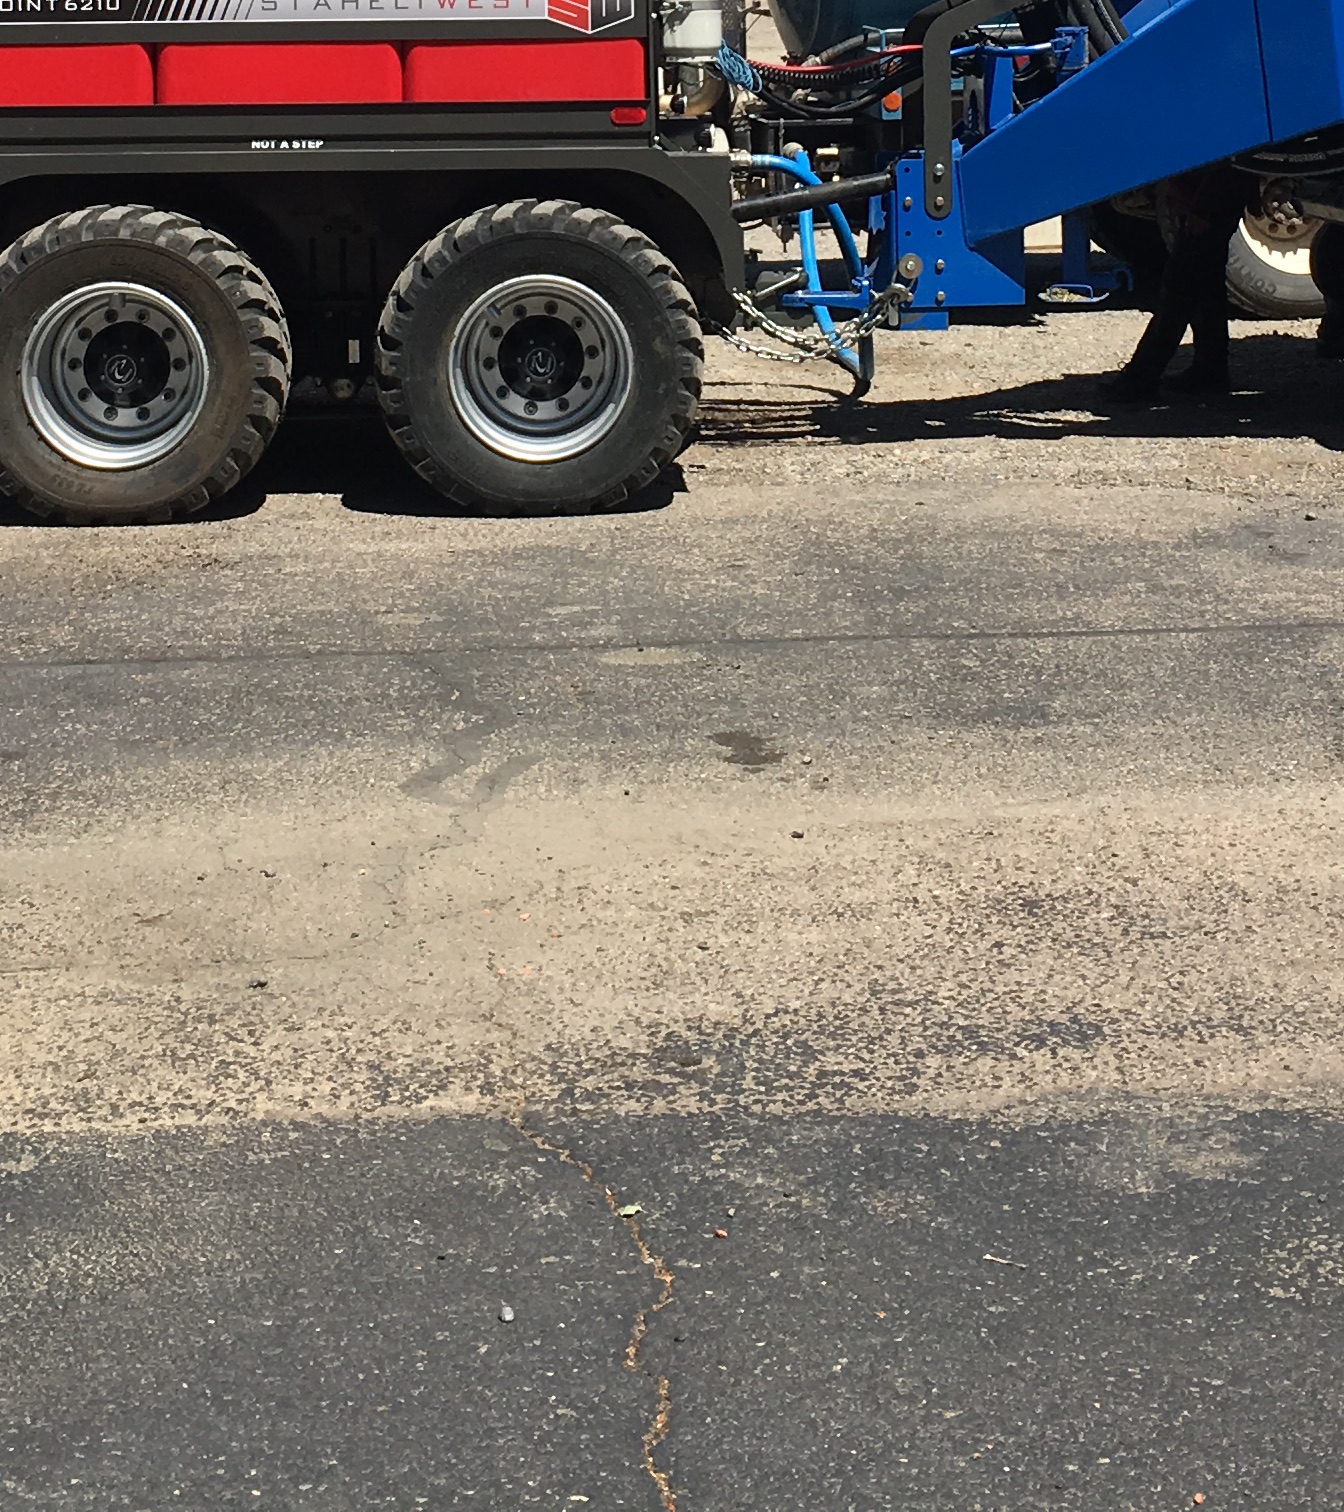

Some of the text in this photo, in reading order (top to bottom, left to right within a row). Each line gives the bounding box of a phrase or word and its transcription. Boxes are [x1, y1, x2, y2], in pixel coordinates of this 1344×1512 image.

[251, 139, 324, 149] NOT A STEP
